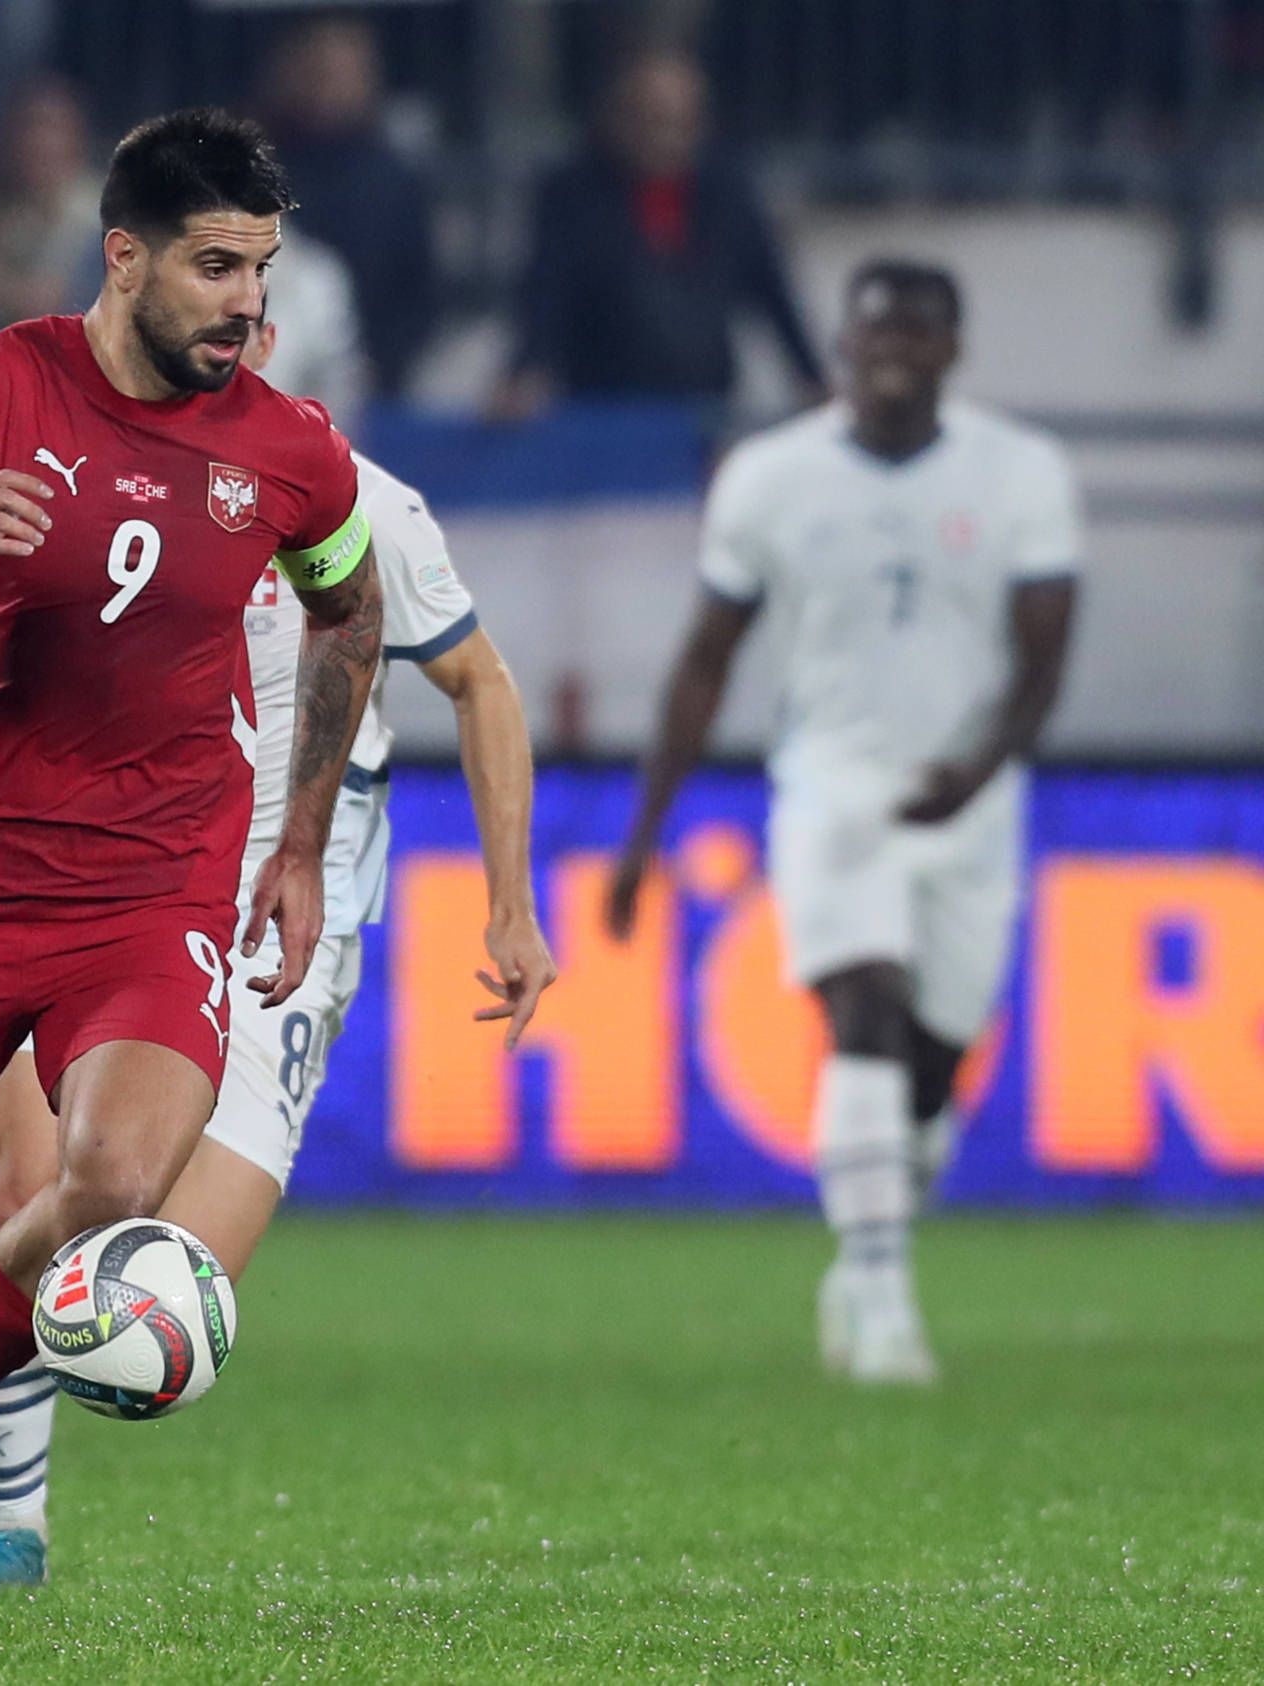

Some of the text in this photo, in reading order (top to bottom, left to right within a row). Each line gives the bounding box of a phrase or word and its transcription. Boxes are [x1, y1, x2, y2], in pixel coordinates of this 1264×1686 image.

[99, 519, 162, 624] 9
[185, 930, 225, 1008] 9
[278, 1011, 312, 1107] 8
